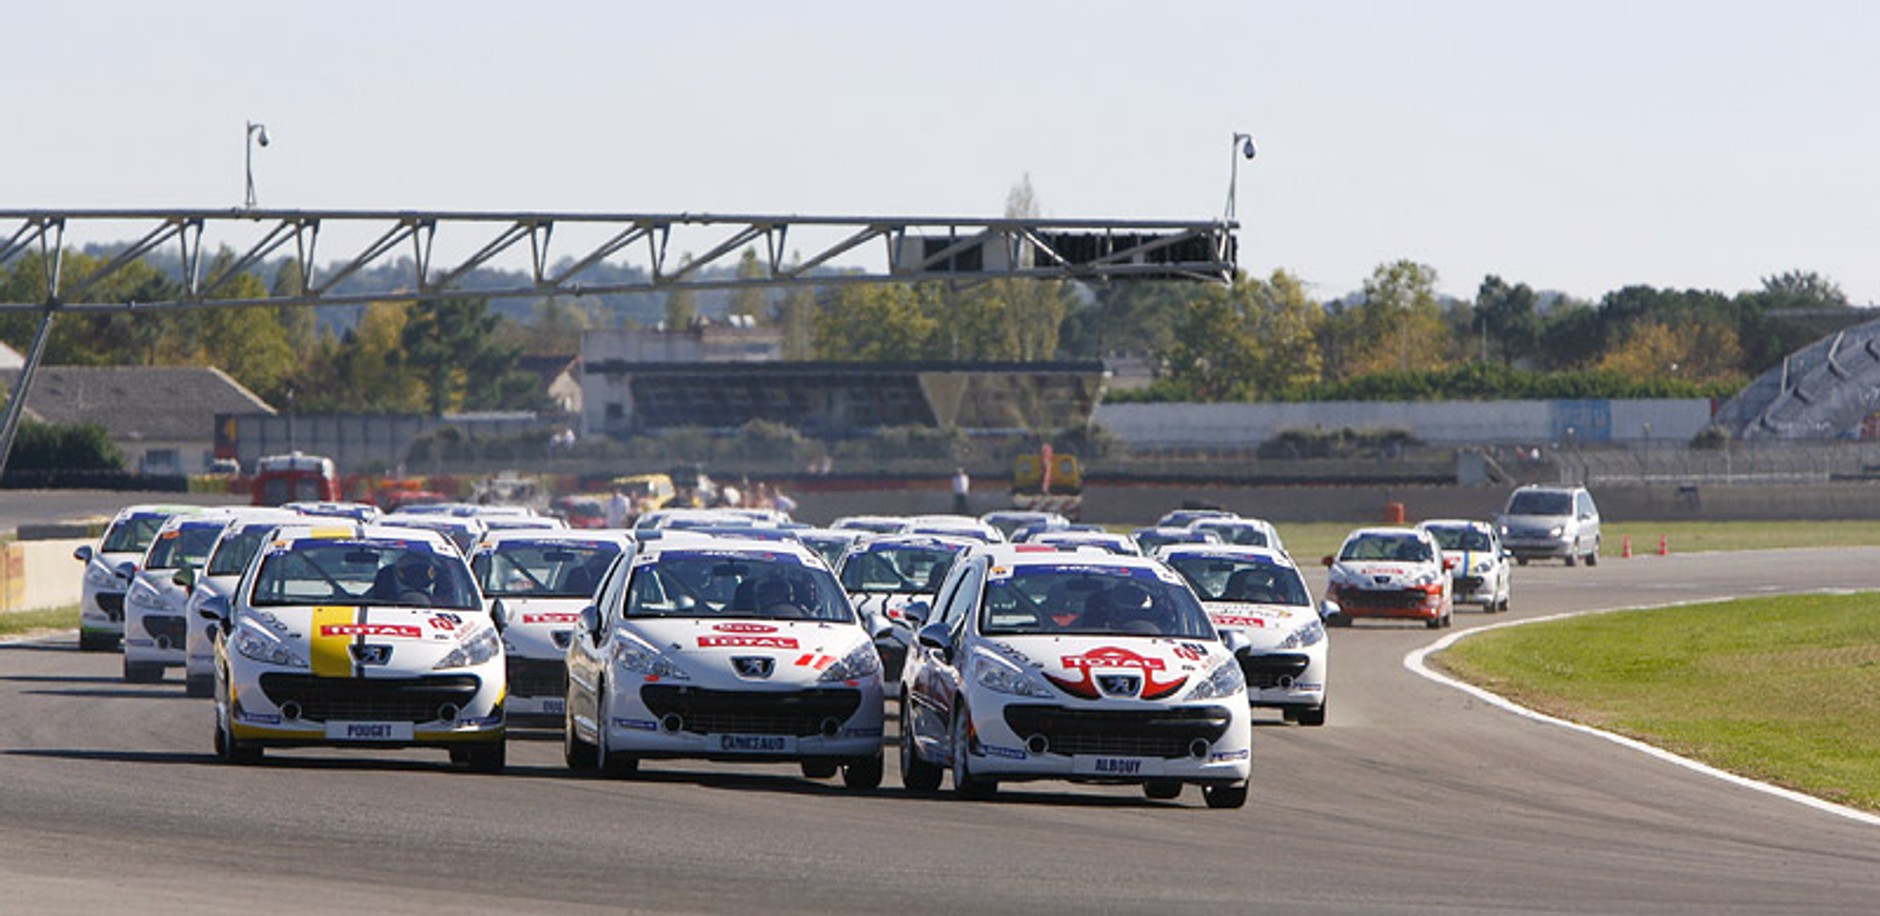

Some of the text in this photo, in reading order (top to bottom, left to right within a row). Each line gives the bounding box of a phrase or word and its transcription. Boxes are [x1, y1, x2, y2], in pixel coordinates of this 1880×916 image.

[328, 626, 417, 636] TOTAL
[707, 636, 794, 648] TOTAL
[1065, 657, 1161, 669] TOTAL
[347, 723, 392, 737] POUGET
[1095, 758, 1142, 773] ALBOUY
